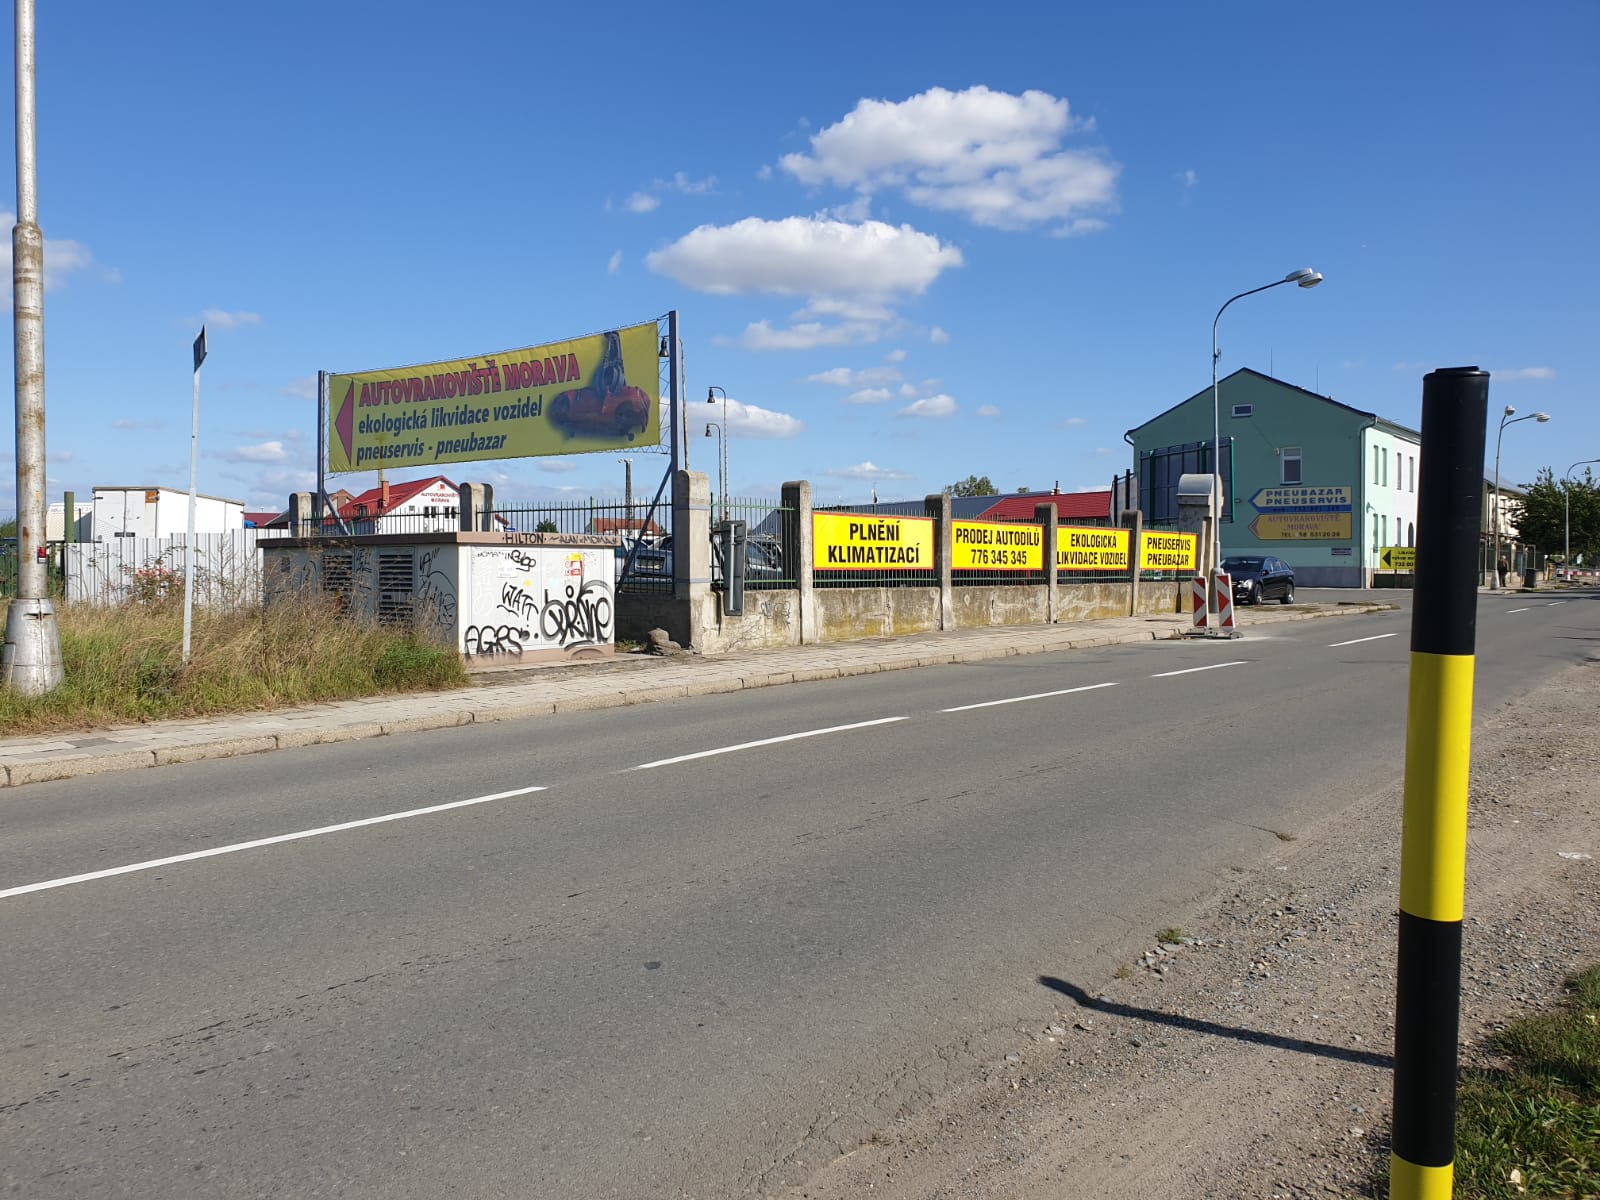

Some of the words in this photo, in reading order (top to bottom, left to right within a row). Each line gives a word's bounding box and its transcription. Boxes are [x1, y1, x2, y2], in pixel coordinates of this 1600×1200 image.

[358, 359, 500, 408] AUTOVRAKOVIŠTĚ
[504, 353, 581, 391] MORAVA
[358, 408, 428, 438] ekologická
[430, 402, 490, 428] likvidace
[493, 395, 542, 420] vozidel
[356, 436, 425, 466] pneuservis
[434, 431, 507, 460] pneubazar
[1265, 488, 1343, 497] PNEUBAZAR
[1265, 496, 1347, 505] PNEUSERVIS
[849, 519, 900, 541] PLNĚNÍ
[955, 527, 993, 545] PRODEJ
[995, 527, 1040, 546] AUTODÍLŮ
[505, 533, 544, 545] HILTON
[1070, 531, 1117, 548] EKOLOGICKÁ
[1147, 537, 1191, 551] PNEUSERVIS
[827, 542, 920, 564] KLIMATIZACÍ
[971, 549, 988, 564] 776
[991, 549, 1008, 565] 345
[1010, 550, 1027, 565] 345
[1056, 551, 1098, 565] LIKVIDACE
[1100, 552, 1127, 566] VOZIDEL
[1147, 553, 1189, 566] PNEUBAZAR
